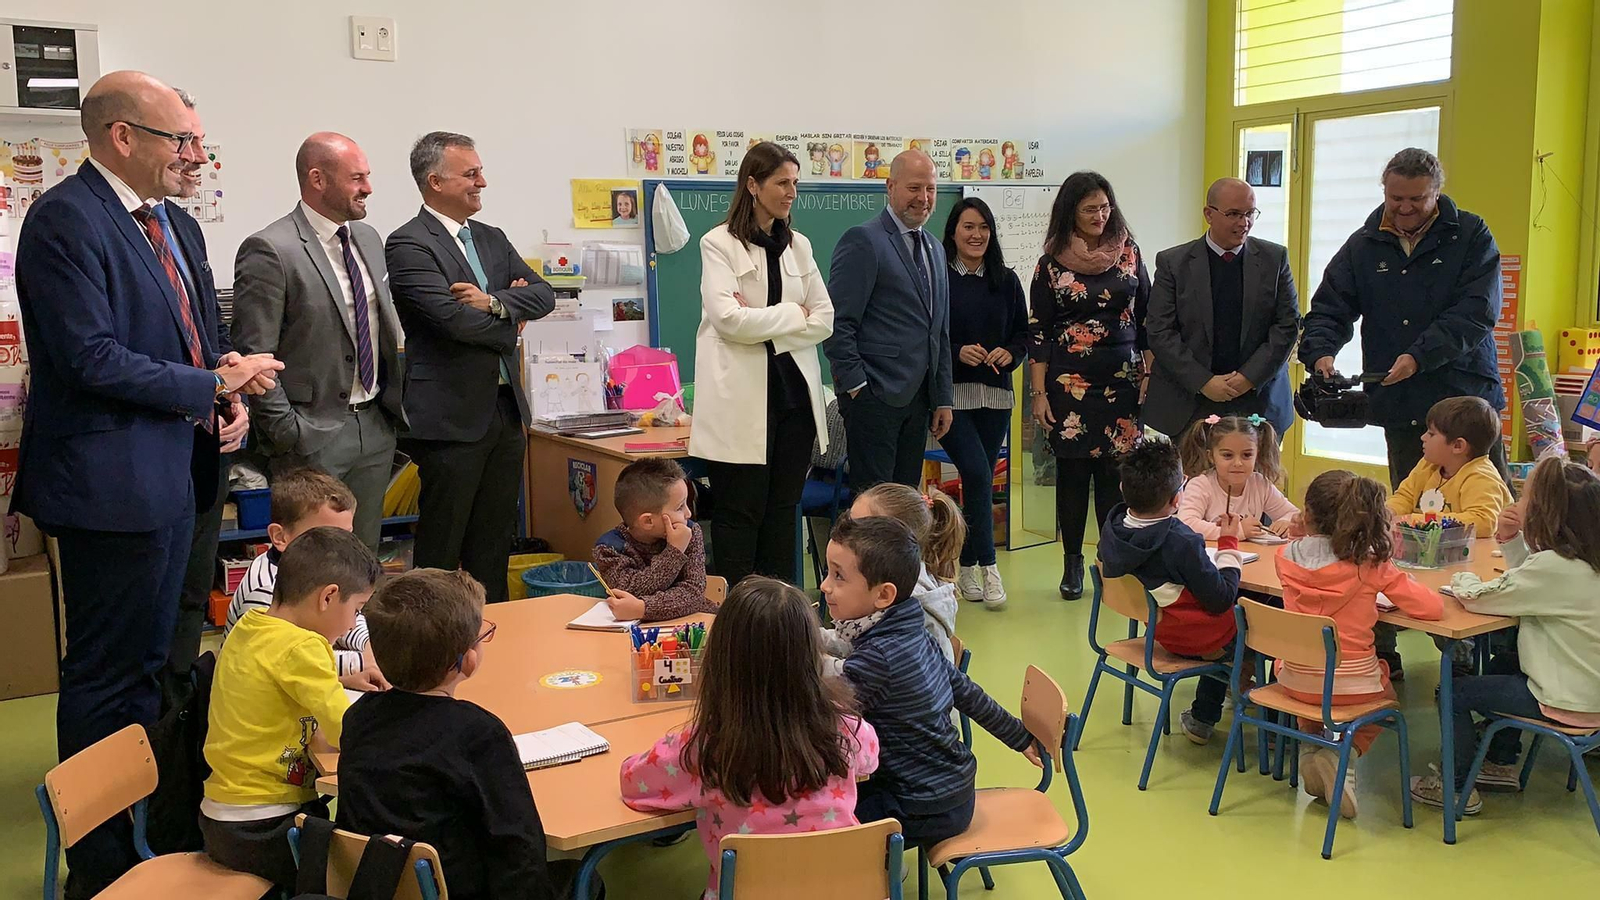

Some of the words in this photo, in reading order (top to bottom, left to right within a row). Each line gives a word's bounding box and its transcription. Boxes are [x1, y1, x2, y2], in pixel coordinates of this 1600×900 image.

[1028, 141, 1039, 149] USAR
[1025, 169, 1044, 178] PAPELERA
[680, 192, 730, 212] LUNES
[797, 194, 874, 211] NOVIEMBRE
[664, 660, 672, 673] 4
[658, 675, 683, 684] Cuatro
